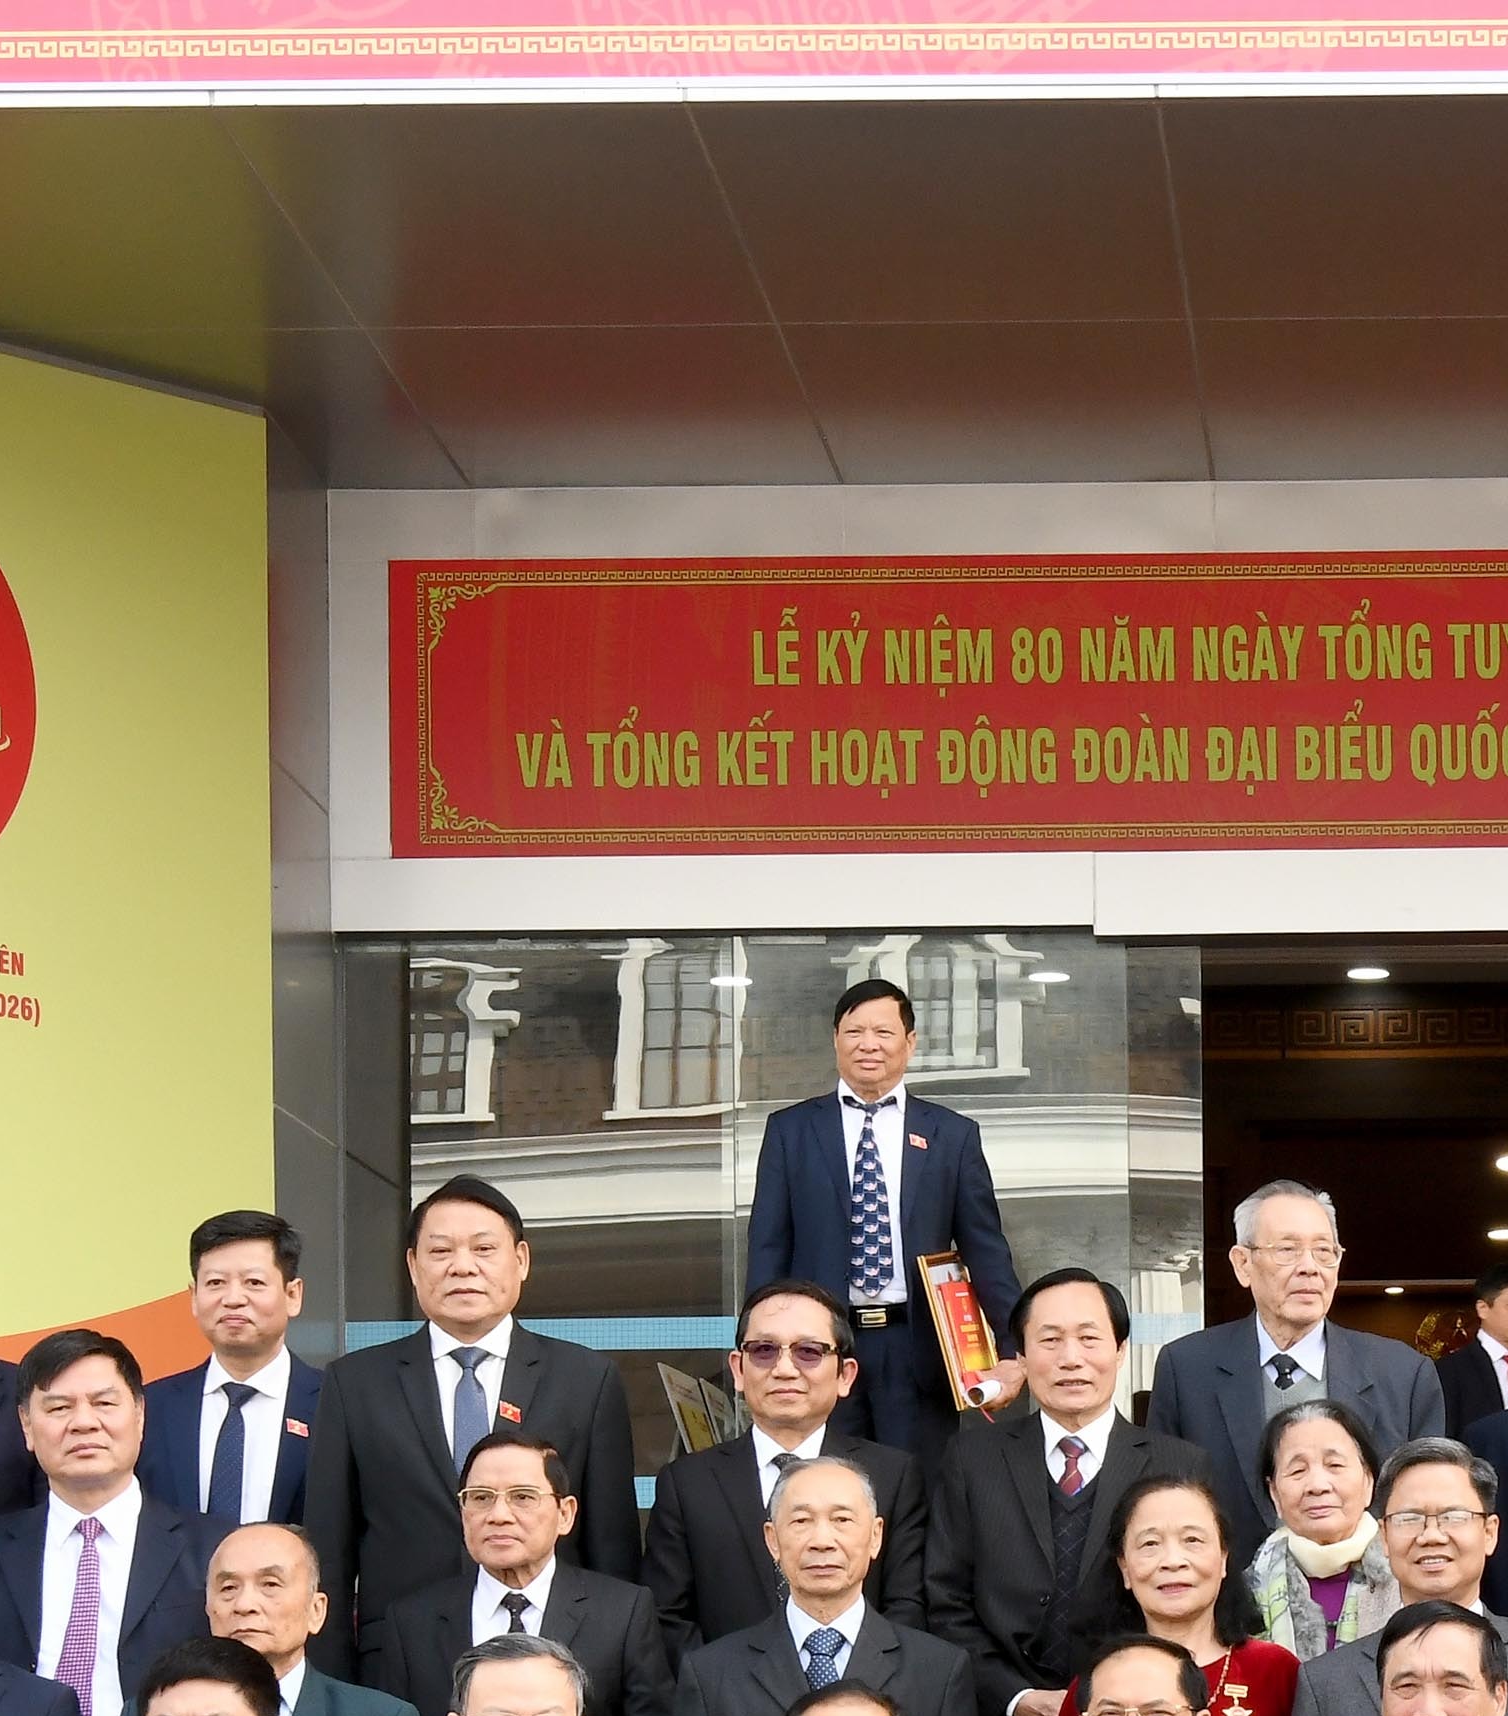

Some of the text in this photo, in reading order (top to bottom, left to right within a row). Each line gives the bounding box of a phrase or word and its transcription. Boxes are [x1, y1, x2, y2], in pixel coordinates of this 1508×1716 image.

[752, 607, 800, 686] LỄ
[817, 611, 869, 685] KỶ
[884, 613, 993, 698] NIỆM
[1011, 627, 1063, 684] 80
[1080, 616, 1175, 683] NĂM
[1192, 611, 1305, 682] NGÀY
[1317, 598, 1432, 681] TỔNG
[515, 718, 573, 788] VÀ
[586, 705, 701, 789] TỔNG
[717, 710, 795, 786] KẾT
[810, 728, 924, 799] HOẠT
[936, 714, 1057, 798] ĐỘNG
[1071, 713, 1190, 785] ĐOÀN
[1204, 726, 1278, 796] ĐẠI
[1295, 699, 1393, 782] BIỂU
